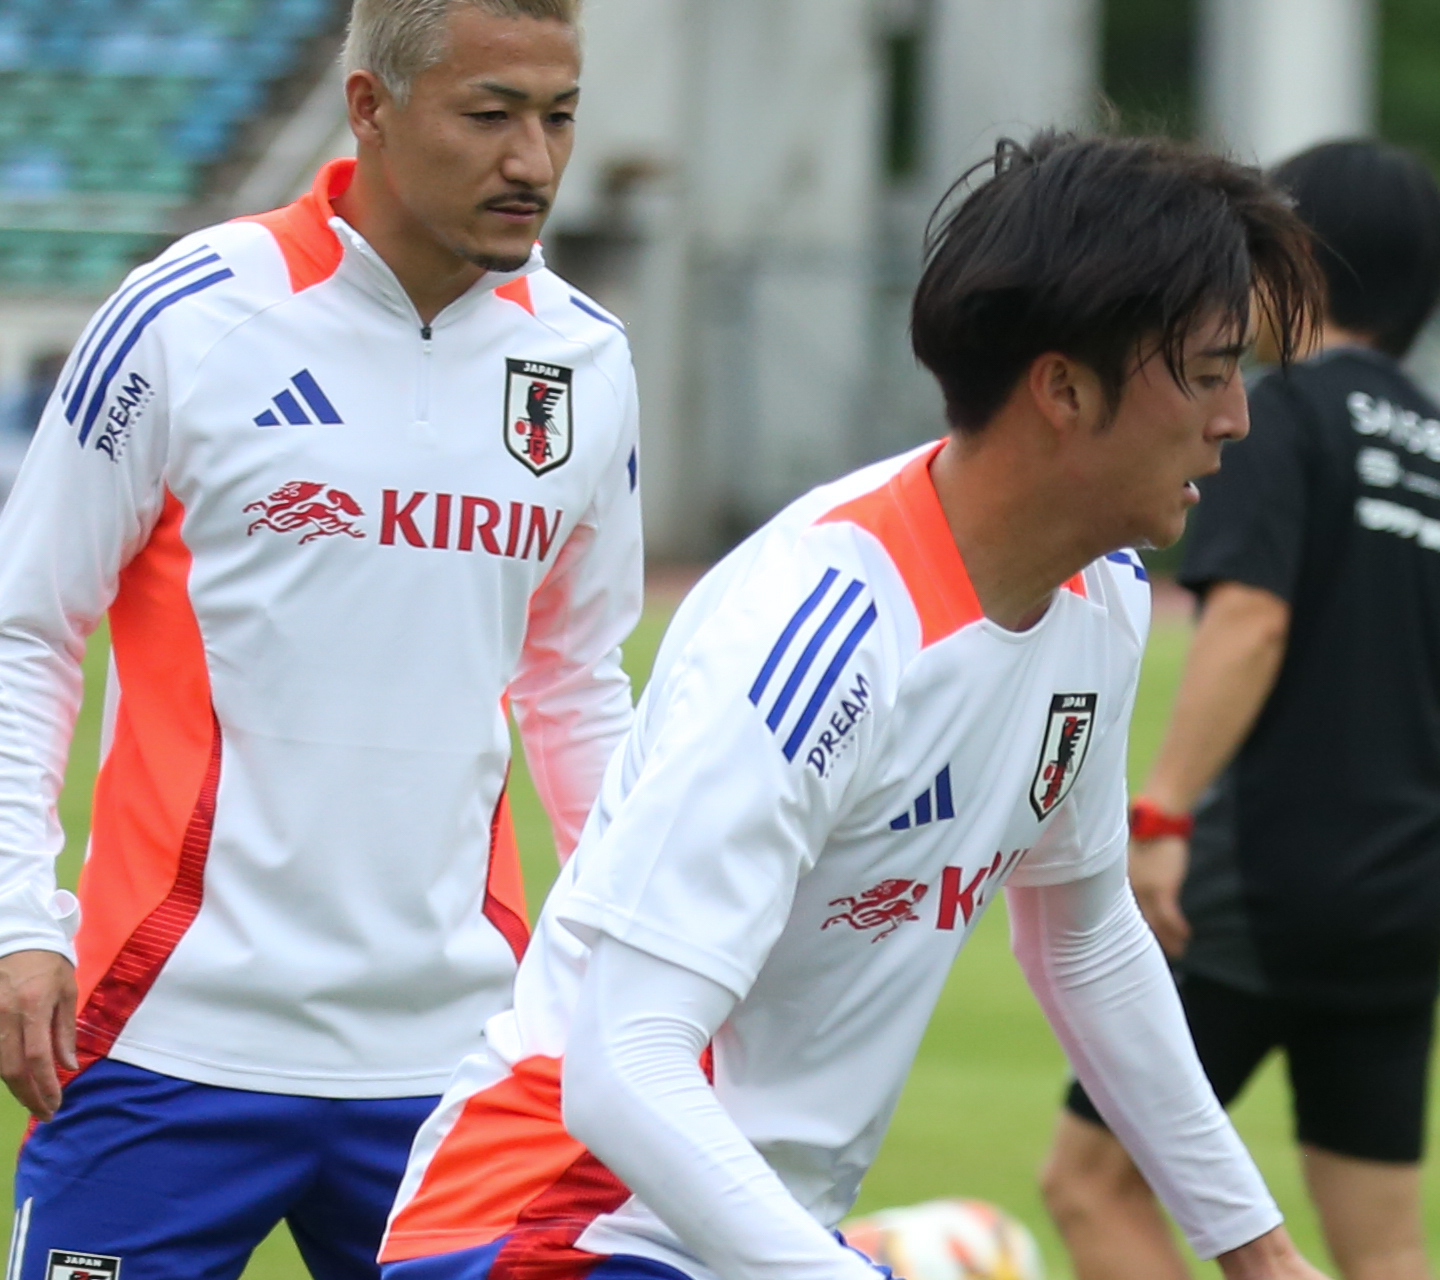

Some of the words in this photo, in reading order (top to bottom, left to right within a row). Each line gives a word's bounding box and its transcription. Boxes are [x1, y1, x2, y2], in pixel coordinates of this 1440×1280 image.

[523, 362, 560, 378] JAPAN
[95, 372, 150, 461] DREAM
[379, 489, 562, 562] KIRIN
[807, 673, 871, 778] DREAM
[64, 1256, 102, 1267] JAPAN
